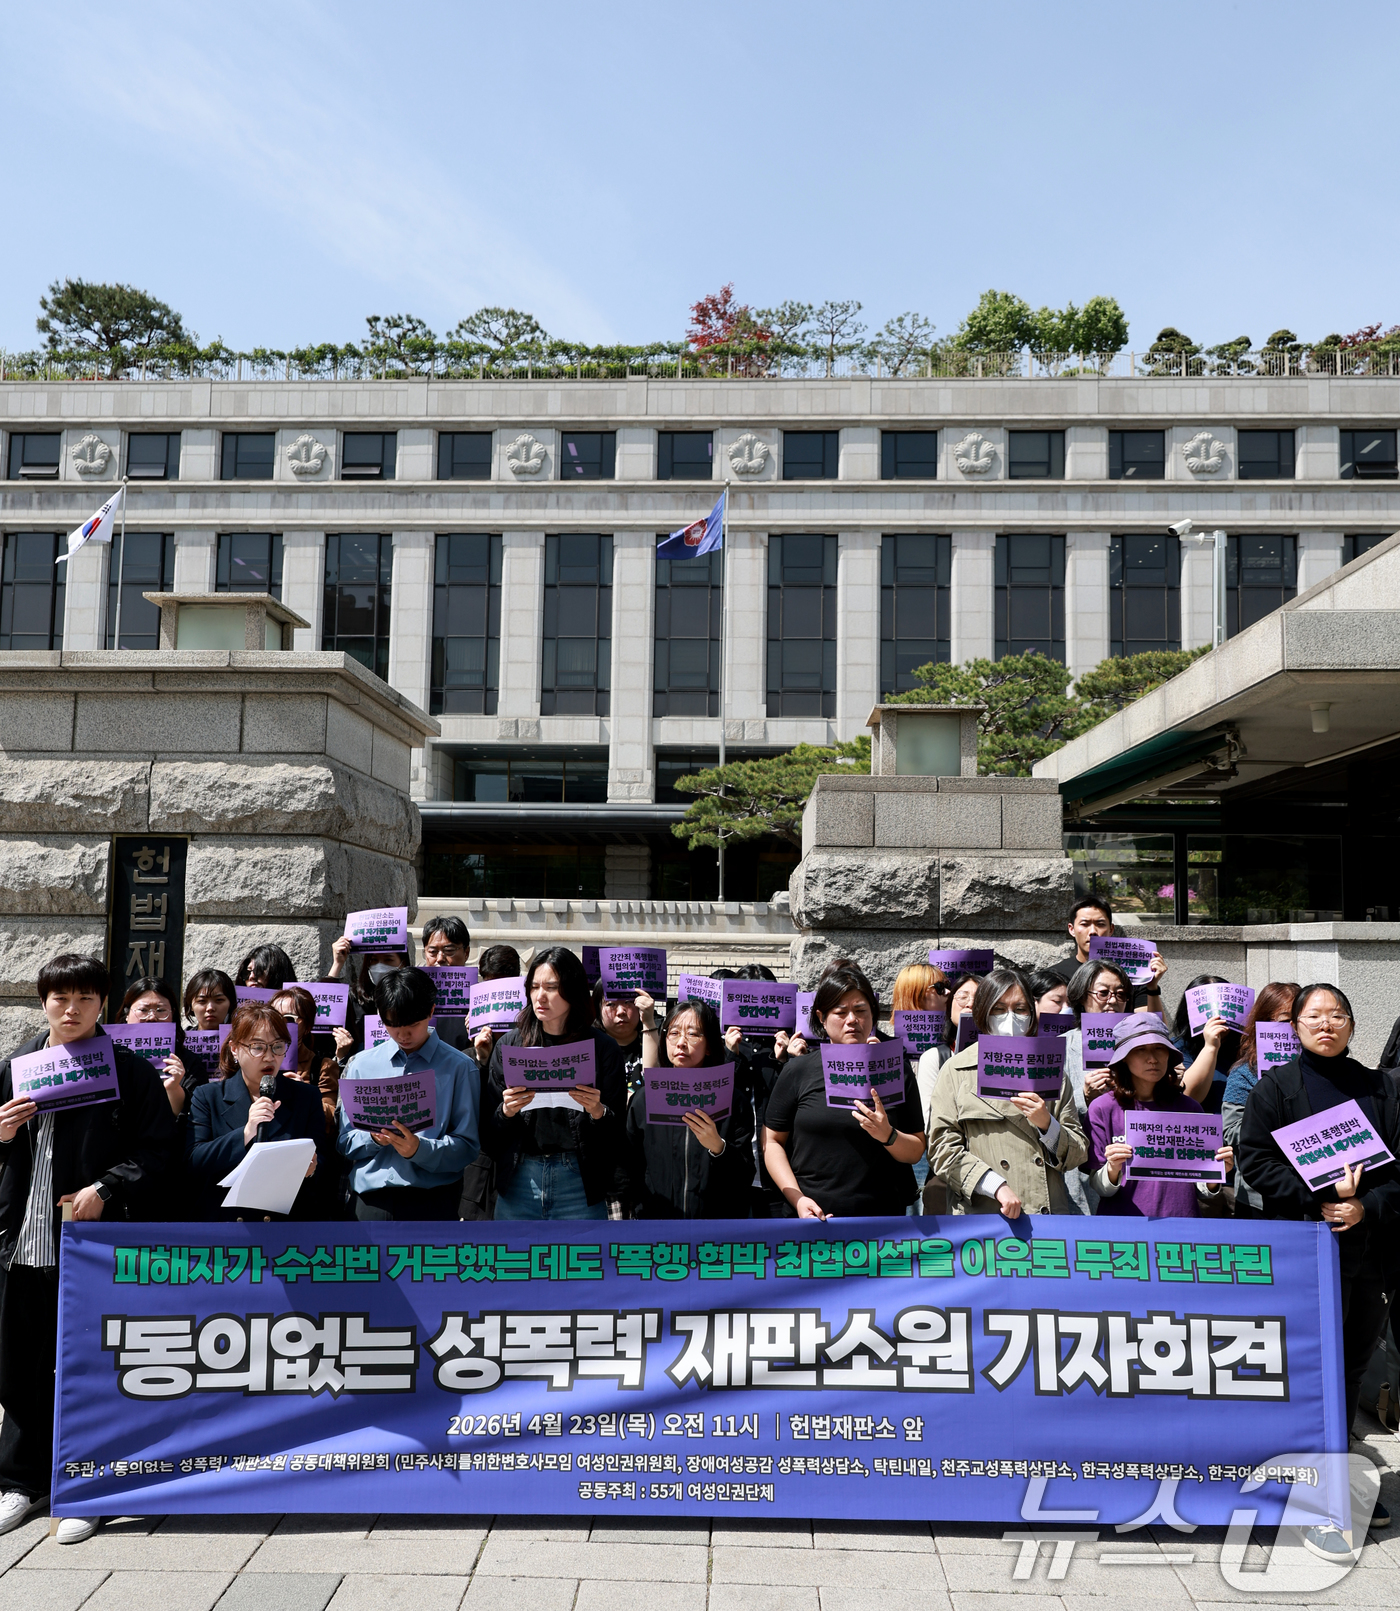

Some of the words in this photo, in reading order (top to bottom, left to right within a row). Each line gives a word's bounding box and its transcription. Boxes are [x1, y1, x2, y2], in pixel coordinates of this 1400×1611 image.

[1104, 941, 1145, 950] 헌법재판소는
[610, 953, 631, 962] 강간죄
[1096, 948, 1124, 958] 재판소원
[1124, 949, 1152, 960] 인용하여
[608, 962, 638, 971] 최협의설'
[638, 962, 662, 971] 폐기하고
[935, 961, 958, 970] 강간죄
[438, 972, 467, 980] '폭행협박
[685, 978, 704, 987] '여성의
[444, 980, 471, 989] 폐기하고
[313, 994, 344, 1003] 성폭력도
[473, 995, 489, 1006] 강간죄
[490, 989, 521, 1001] 폭행협박
[726, 993, 759, 1004] 동의없는
[760, 995, 793, 1005] 성폭력도
[1234, 987, 1249, 998] 아닌
[491, 1001, 523, 1013] 폐기하라
[738, 1005, 780, 1020] 강간이다
[1221, 1001, 1244, 1014] 기본권
[902, 1014, 926, 1023] '여성의
[370, 1029, 389, 1038] 재판소
[902, 1023, 945, 1032] '성적자기결정
[1086, 1027, 1113, 1038] 저항유
[134, 1037, 152, 1048] 묻지
[154, 1037, 172, 1047] 말고
[184, 1036, 199, 1044] 간죄
[907, 1032, 931, 1042] 헌법상
[1259, 1032, 1289, 1040] 피해자의
[1087, 1039, 1116, 1051] 동의여
[21, 1062, 56, 1079] 강간죄
[58, 1051, 104, 1070] 폭행협박
[508, 1057, 548, 1068] 동의없는
[551, 1052, 591, 1068] 성폭력도
[827, 1060, 865, 1072] 저항유무
[867, 1059, 885, 1072] 묻지
[886, 1056, 901, 1068] 말고
[983, 1052, 1024, 1064] 저항유무
[1026, 1053, 1045, 1065] 묻지
[1046, 1053, 1062, 1064] 말고
[18, 1073, 64, 1093] 최협의설
[65, 1063, 111, 1083] 폐기하라
[523, 1067, 577, 1081] 강간이다
[829, 1073, 868, 1087] 동의여부
[868, 1068, 901, 1087] 질문하라
[983, 1064, 1025, 1078] 동의여부
[1026, 1066, 1061, 1080] 질문하라
[354, 1085, 381, 1095] 강간죄
[383, 1080, 421, 1094] '폭행협박
[650, 1080, 690, 1092] 동의없는
[692, 1076, 730, 1092] 성폭력도
[353, 1095, 390, 1105] 최협의설'
[391, 1090, 427, 1103] 폐기하고
[665, 1092, 717, 1108] 강간이다
[362, 1105, 399, 1116] 피해자의
[399, 1101, 418, 1114] 성적
[352, 1113, 395, 1126] 자기결정권
[1130, 1122, 1163, 1133] 피해자의
[1165, 1124, 1182, 1134] 수십
[1183, 1125, 1200, 1135] 차례
[1201, 1126, 1220, 1137] 거절,
[1289, 1133, 1322, 1153] 강간죄
[1319, 1117, 1362, 1141] 폭행협박
[1146, 1134, 1205, 1148] 헌법재판소는
[1295, 1144, 1336, 1166] 최협의설
[1332, 1128, 1374, 1152] 폐기하라
[1134, 1145, 1175, 1160] 재판소원
[1176, 1148, 1216, 1161] 인용하라
[113, 1245, 268, 1285] 피해자가
[273, 1245, 381, 1283] 수십번
[385, 1242, 605, 1283] 거부했는데도
[775, 1239, 956, 1279] 최협의설'을
[961, 1237, 1071, 1278] 이유로
[1075, 1239, 1151, 1281] 무죄
[1155, 1241, 1275, 1285] 판단된
[101, 1312, 420, 1399] '동의없는
[423, 1307, 664, 1395] 성폭력'
[664, 1306, 975, 1394] 재판소원
[980, 1308, 1291, 1402] 기자회견
[446, 1412, 522, 1437] 2026년
[526, 1412, 563, 1437] 4월
[569, 1412, 657, 1441] 23일(목)
[661, 1412, 705, 1439] 오전
[711, 1413, 760, 1439] 11시
[789, 1413, 897, 1441] 헌법재판소
[902, 1415, 925, 1442] 앞
[64, 1460, 95, 1478] 주관
[98, 1464, 105, 1477] :
[108, 1460, 174, 1477] '동의없는
[178, 1455, 228, 1474] 성폭력'
[230, 1454, 289, 1473] 재판소원
[289, 1452, 391, 1472] 공동대책위원회
[394, 1452, 573, 1473] (민주사회를위한변호사모임
[577, 1453, 684, 1475] 여성인권위원회,
[686, 1455, 774, 1475] 장애여성공감
[777, 1456, 871, 1478] 성폭력상담소,
[873, 1458, 938, 1479] 탁틴내일,
[940, 1458, 1079, 1481] 천주교성폭력상담소,
[1081, 1461, 1205, 1483] 한국성폭력상담소,
[1207, 1464, 1319, 1488] 한국여성의전화)
[578, 1481, 637, 1500] 공동주최
[640, 1486, 646, 1500] :
[649, 1482, 684, 1501] 55개
[687, 1482, 775, 1503] 여성인권단체
